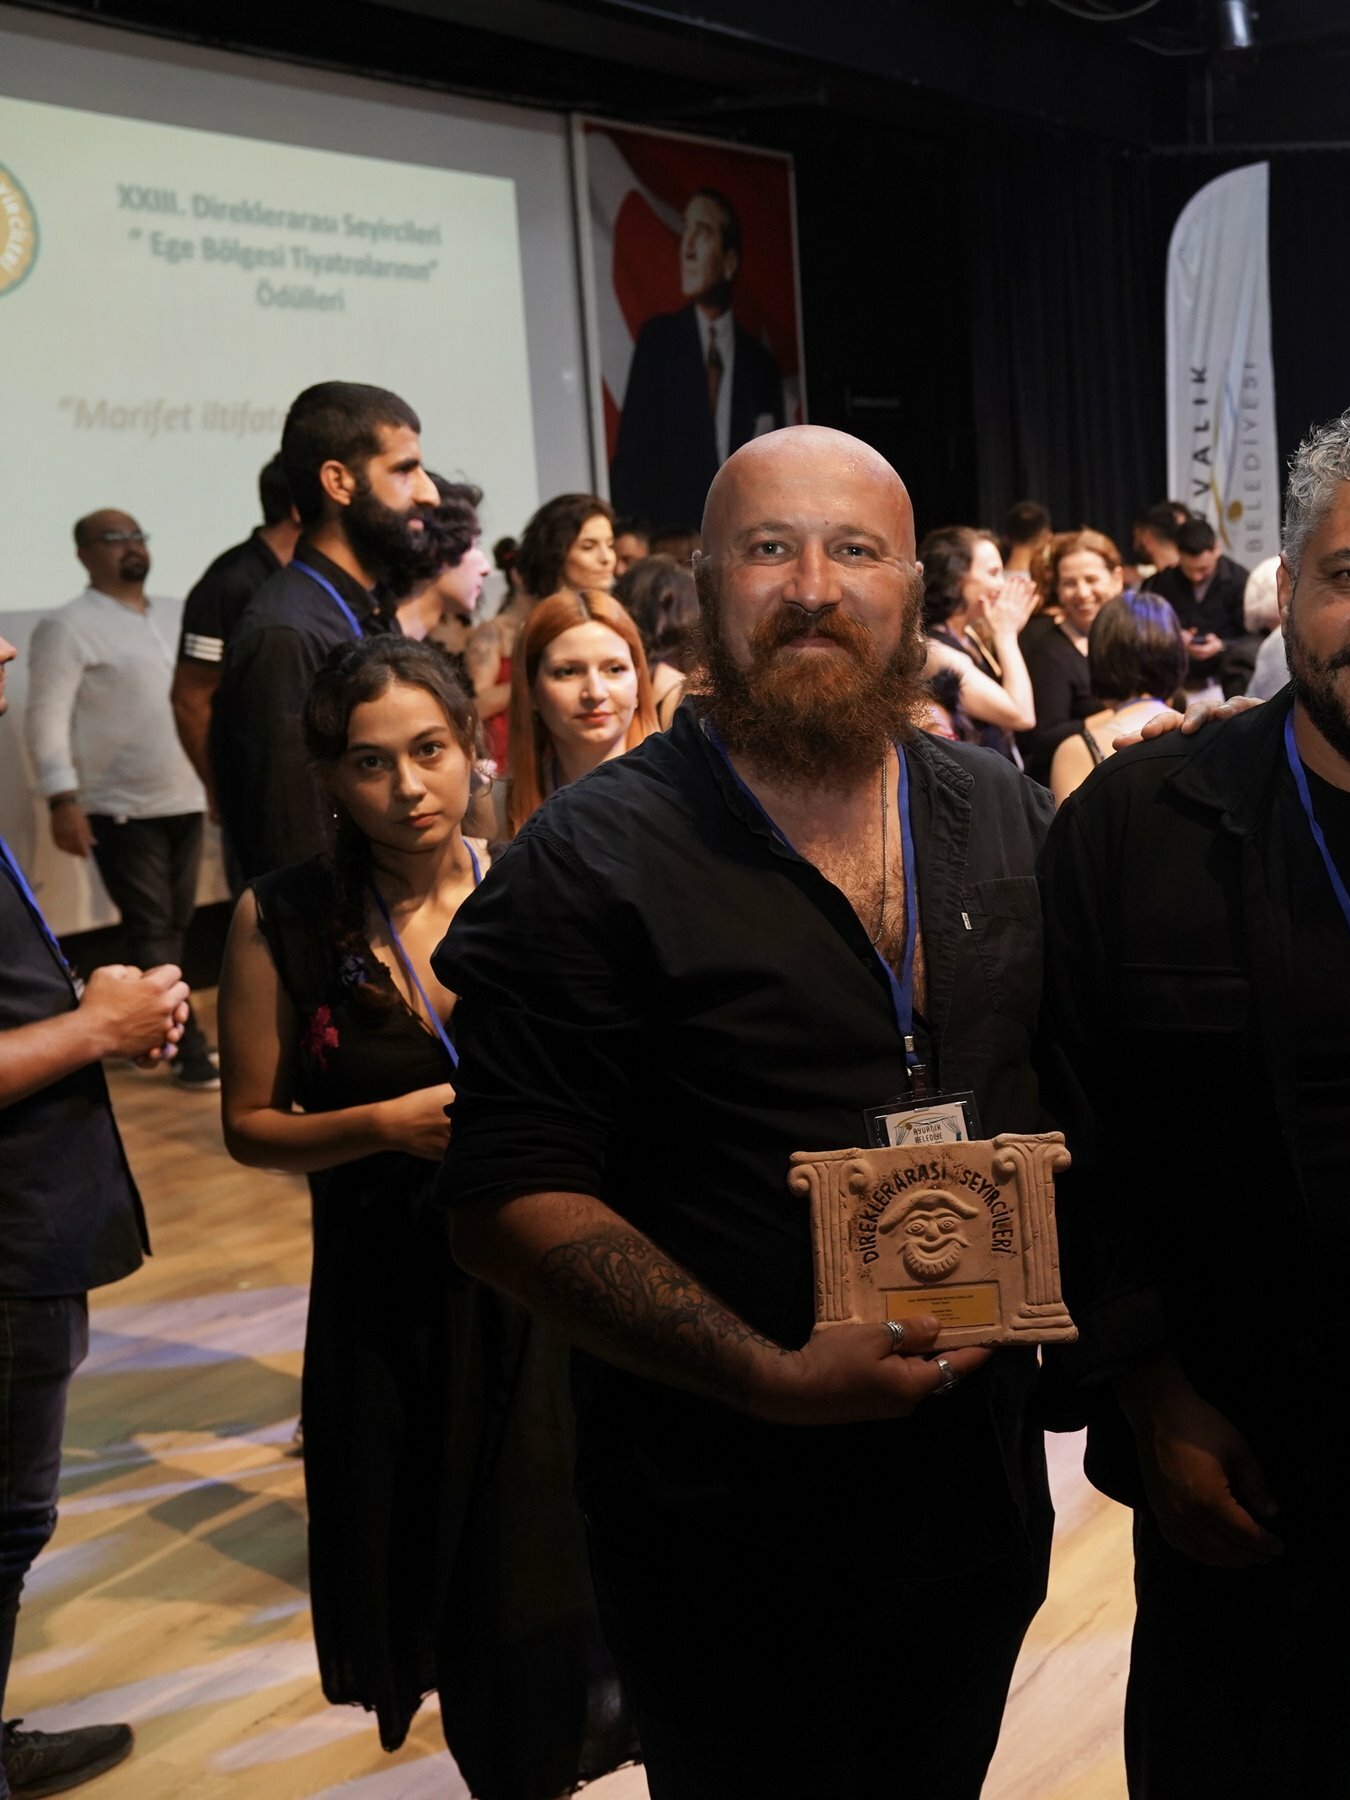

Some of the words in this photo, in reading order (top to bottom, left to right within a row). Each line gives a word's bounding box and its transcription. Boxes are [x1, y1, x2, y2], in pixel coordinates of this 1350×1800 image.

[117, 183, 186, 216] XXIII.
[342, 213, 443, 248] Seyircileri
[149, 230, 195, 264] Ege
[201, 234, 286, 271] Bölgesi
[255, 277, 346, 312] Ödülleri
